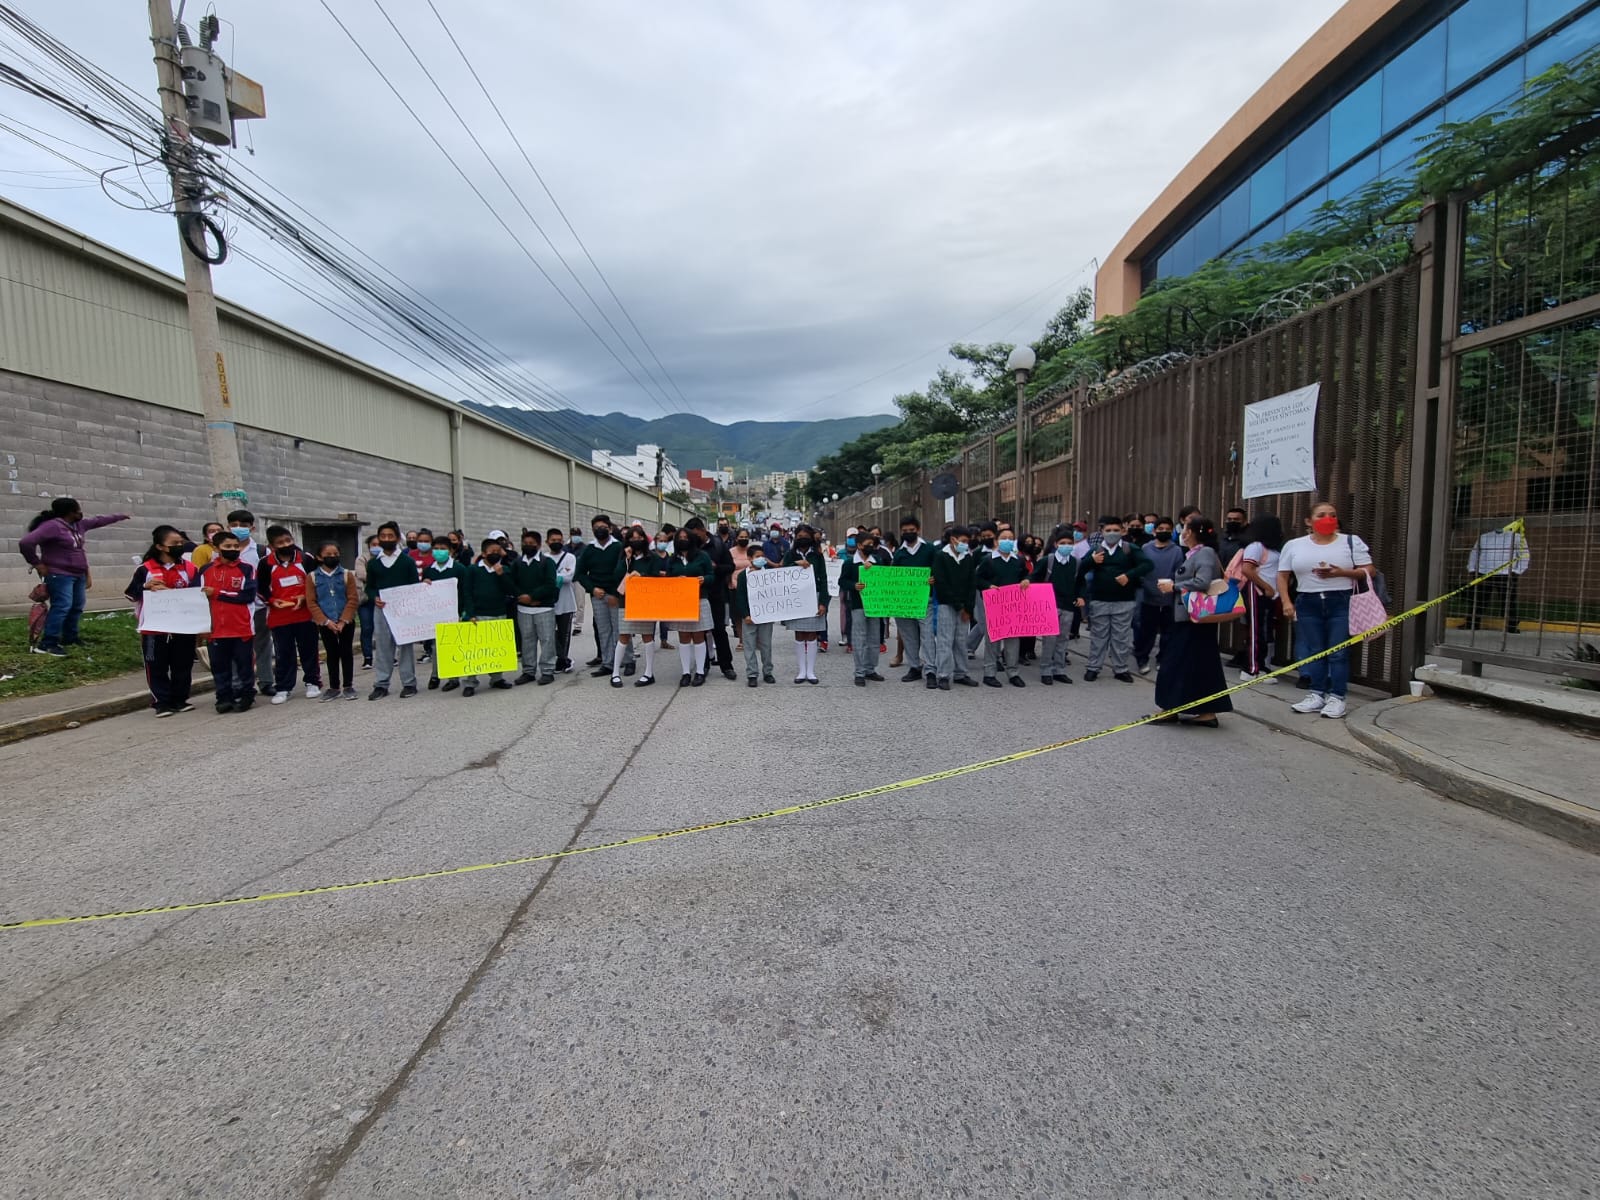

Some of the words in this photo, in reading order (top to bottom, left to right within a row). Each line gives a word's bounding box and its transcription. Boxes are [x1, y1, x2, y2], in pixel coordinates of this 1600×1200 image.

[748, 568, 810, 588] QUEREMOS
[757, 584, 800, 600] AULAS
[985, 590, 1027, 607] SOLUCION
[752, 598, 802, 617] DIGNAS
[1001, 600, 1052, 615] INMEDIATA
[995, 615, 1011, 628] LOS
[1016, 612, 1047, 624] PAGOS
[439, 621, 514, 646] EXIGIMOS
[451, 645, 507, 663] Salones
